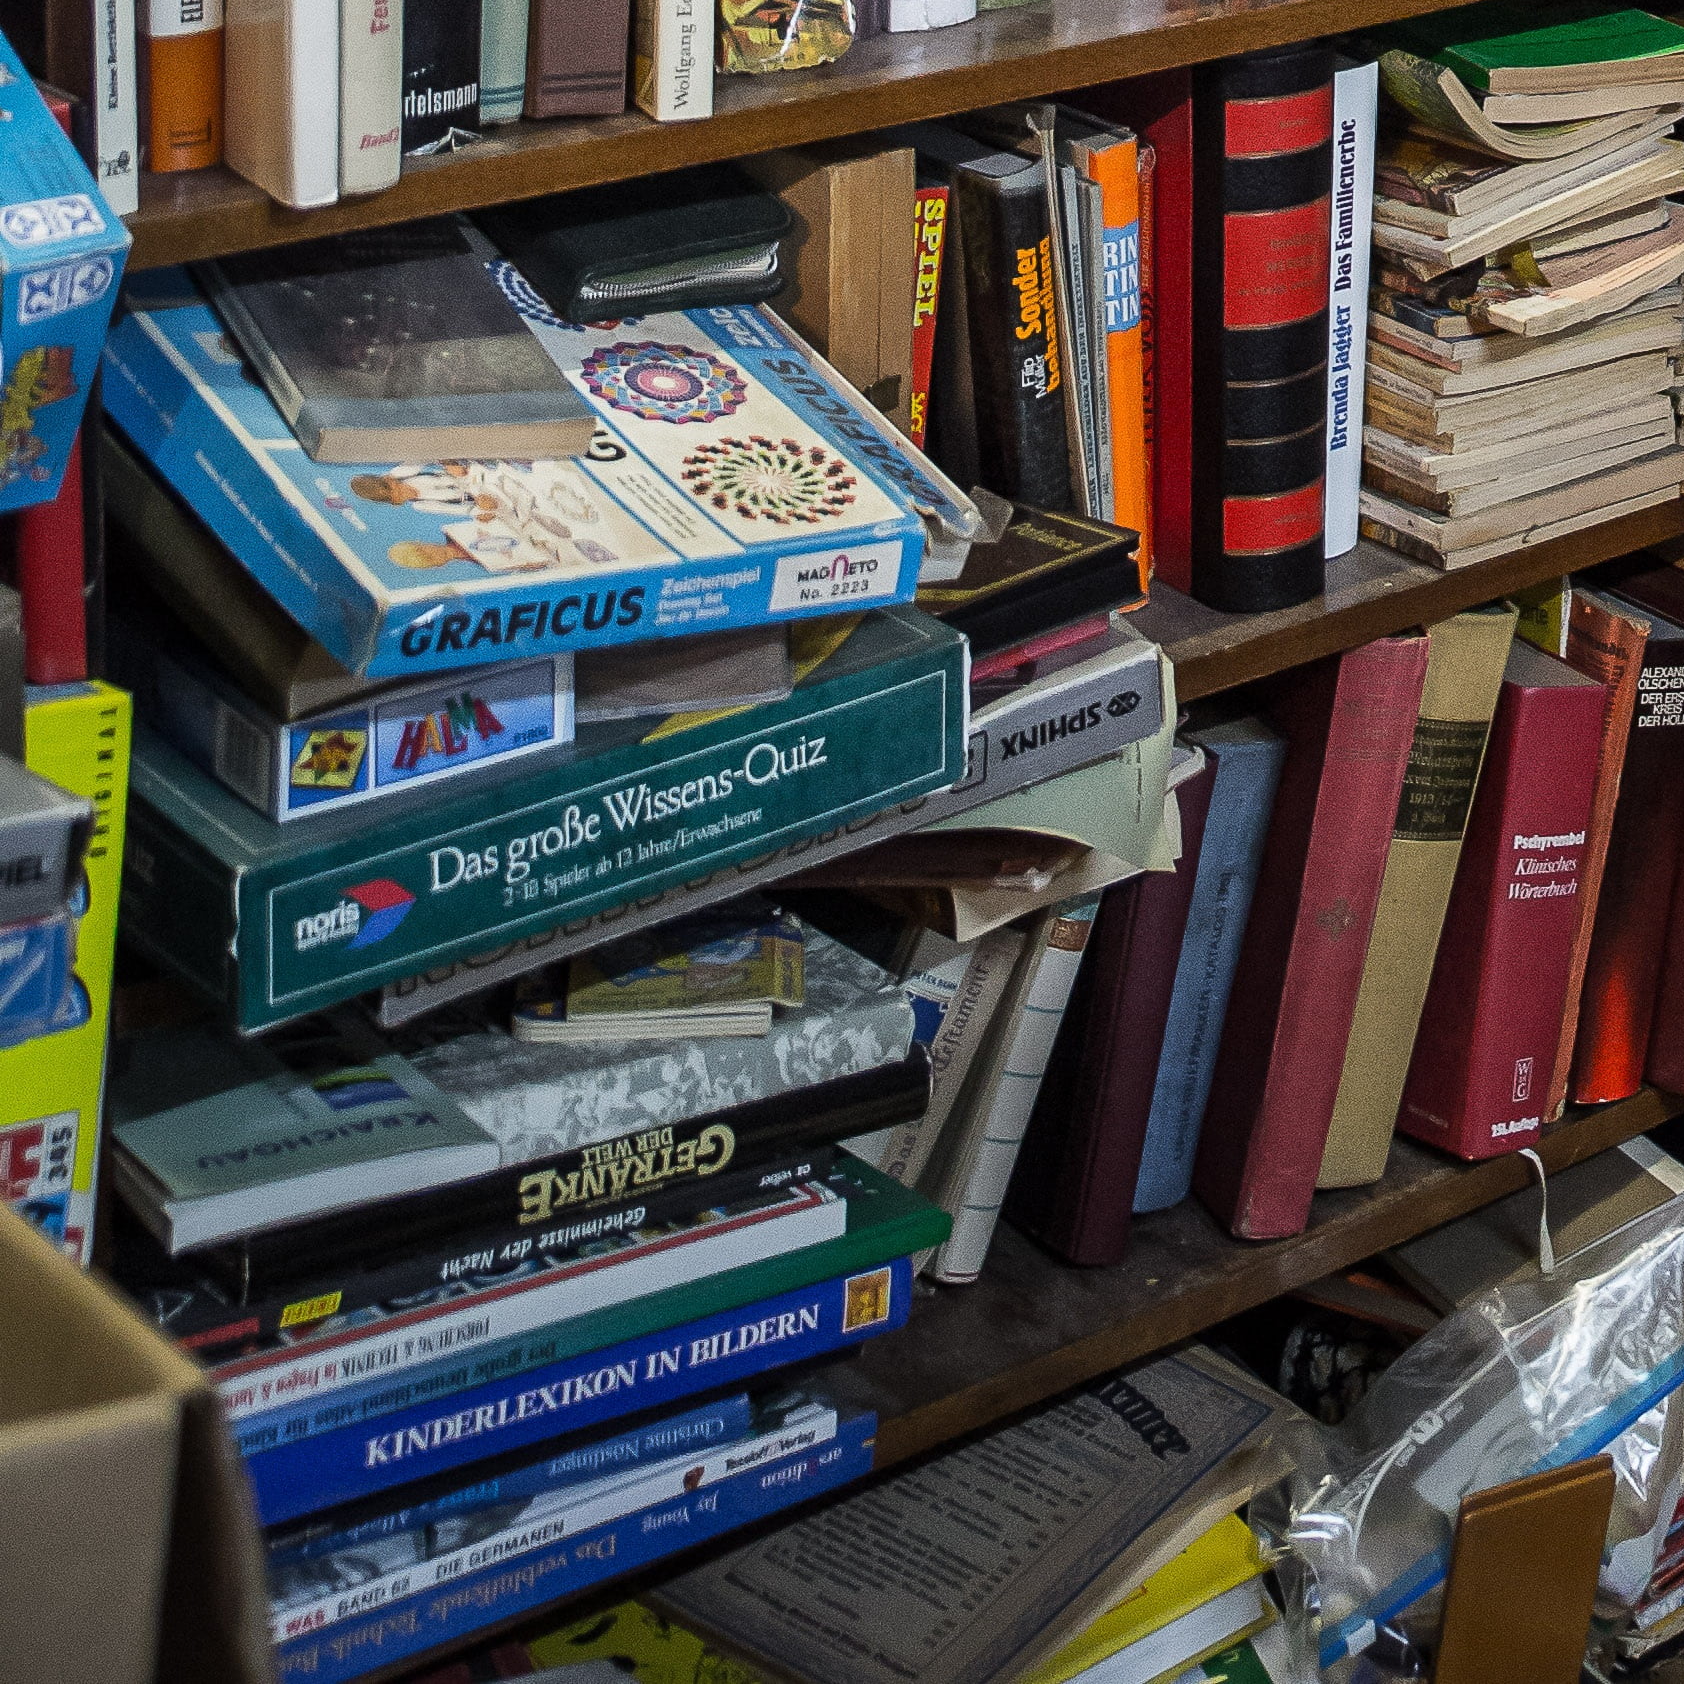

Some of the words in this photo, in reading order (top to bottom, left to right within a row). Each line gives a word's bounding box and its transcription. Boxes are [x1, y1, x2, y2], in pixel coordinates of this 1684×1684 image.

[674, 35, 692, 111] Wolfgang
[1334, 118, 1359, 248] Familienerbe
[1016, 244, 1039, 340] Sonder
[1332, 252, 1354, 293] Das
[1330, 303, 1351, 367] Jagger
[1327, 369, 1349, 451] Brenda
[400, 585, 646, 659] GRAFICUS
[394, 692, 504, 772] HALMA
[1641, 692, 1663, 707] DER
[429, 841, 500, 896] Das
[507, 810, 602, 884] große
[602, 734, 828, 831] Wissens-Quiz
[1513, 830, 1587, 851] Pschyrembel
[1506, 878, 1578, 902] Wörterbuch
[1513, 855, 1577, 878] Klinisches
[365, 1362, 635, 1468] KINDERLEXIKON
[644, 1347, 685, 1380] IN
[688, 1303, 821, 1369] BILDERN
